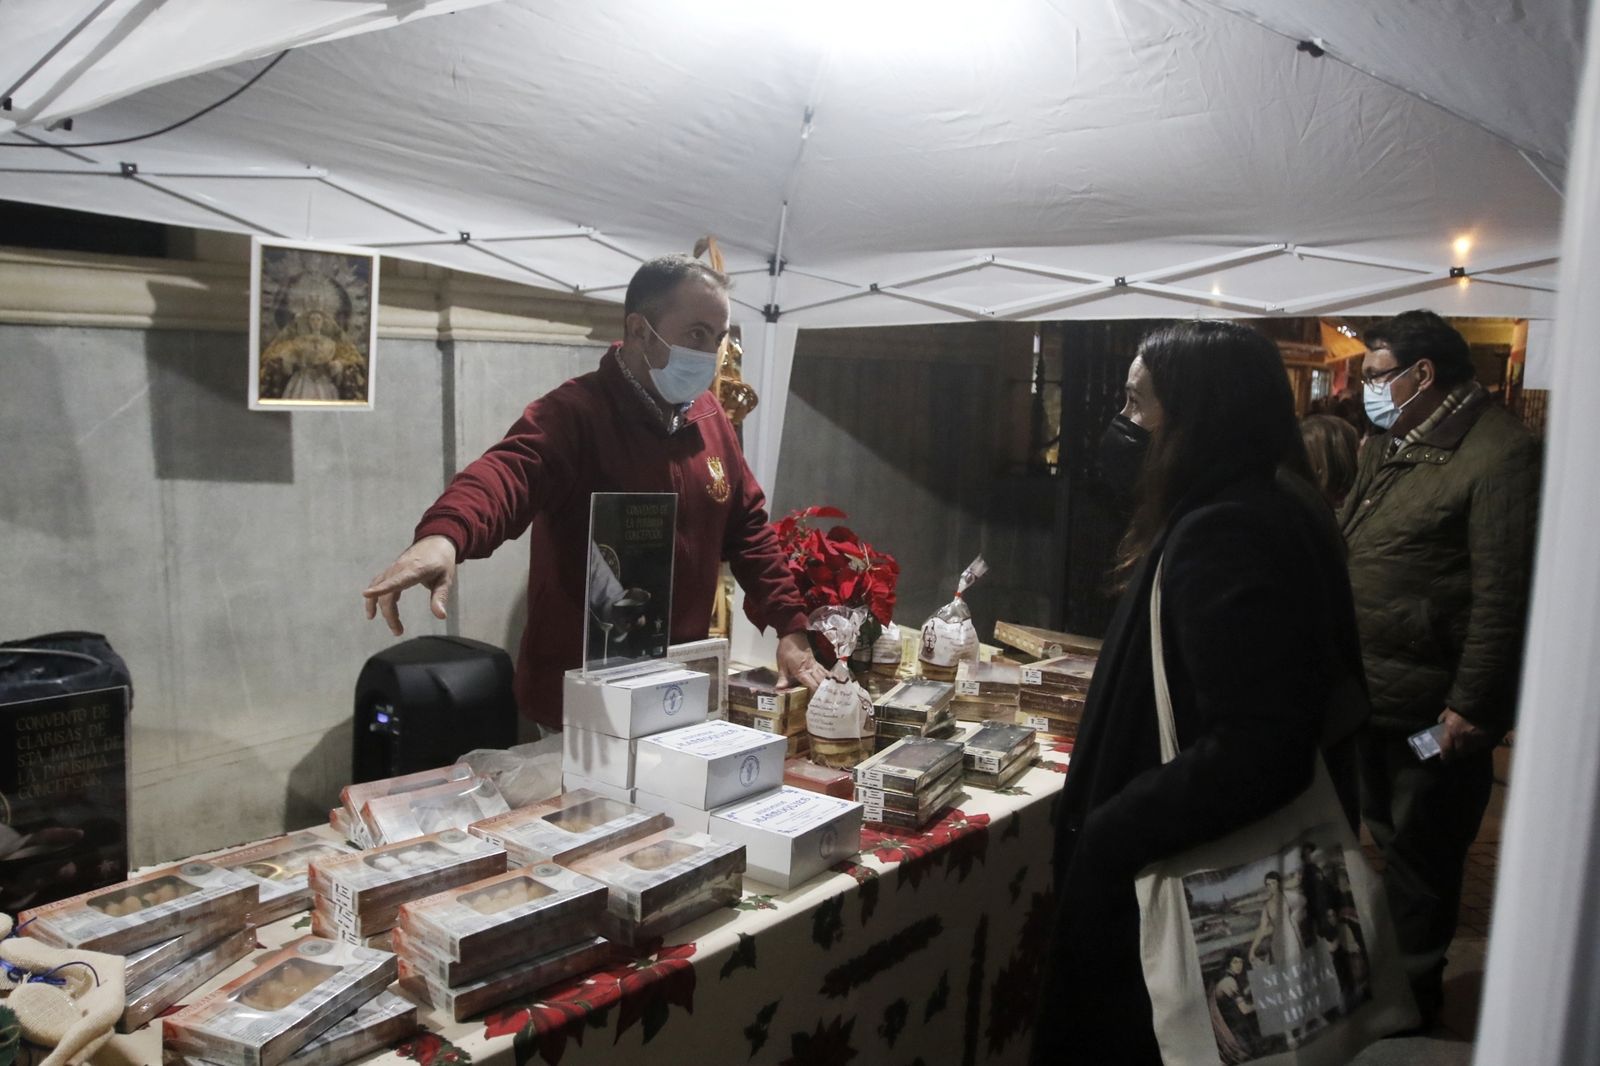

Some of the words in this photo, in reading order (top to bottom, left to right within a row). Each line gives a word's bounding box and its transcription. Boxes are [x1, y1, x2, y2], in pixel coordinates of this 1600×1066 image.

[15, 707, 87, 732] CONVENTO
[92, 703, 110, 720] DE
[16, 727, 82, 750] CLARISAS
[88, 721, 106, 738] DE
